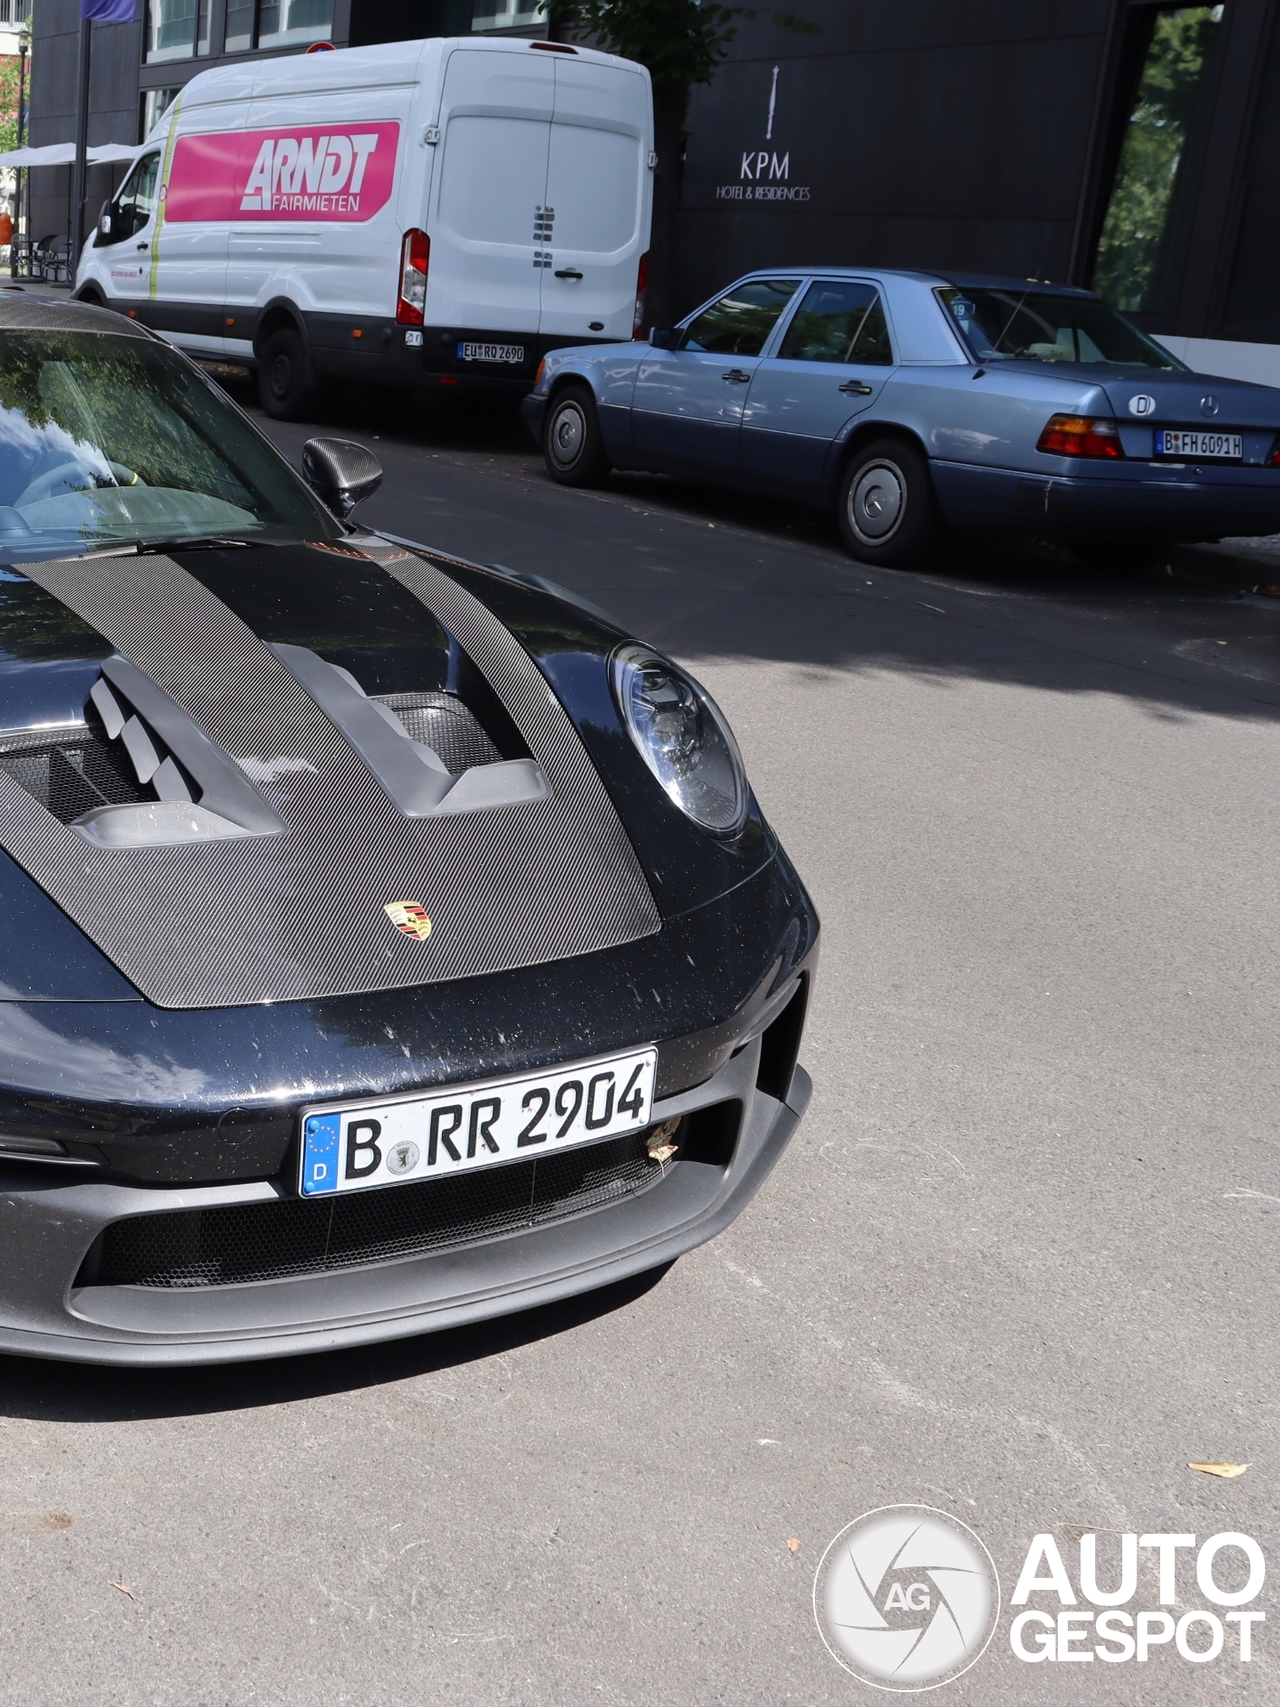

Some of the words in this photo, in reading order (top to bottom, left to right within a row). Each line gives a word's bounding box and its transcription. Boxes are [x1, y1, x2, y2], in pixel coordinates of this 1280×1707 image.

[240, 134, 379, 210] ARNDT
[740, 151, 790, 179] KPM
[716, 186, 743, 199] HOTEL
[745, 186, 753, 199] &
[755, 187, 811, 200] RESIDENCES
[272, 195, 360, 211] FAIRMIETEN
[464, 344, 477, 358] EU
[484, 345, 497, 359] RQ
[499, 346, 523, 360] 2690
[1136, 397, 1148, 413] D
[1165, 433, 1173, 451] B
[1182, 434, 1198, 452] FH
[345, 1118, 382, 1180] B
[427, 1097, 502, 1166] RR
[517, 1063, 645, 1148] 2904
[313, 1163, 327, 1181] D
